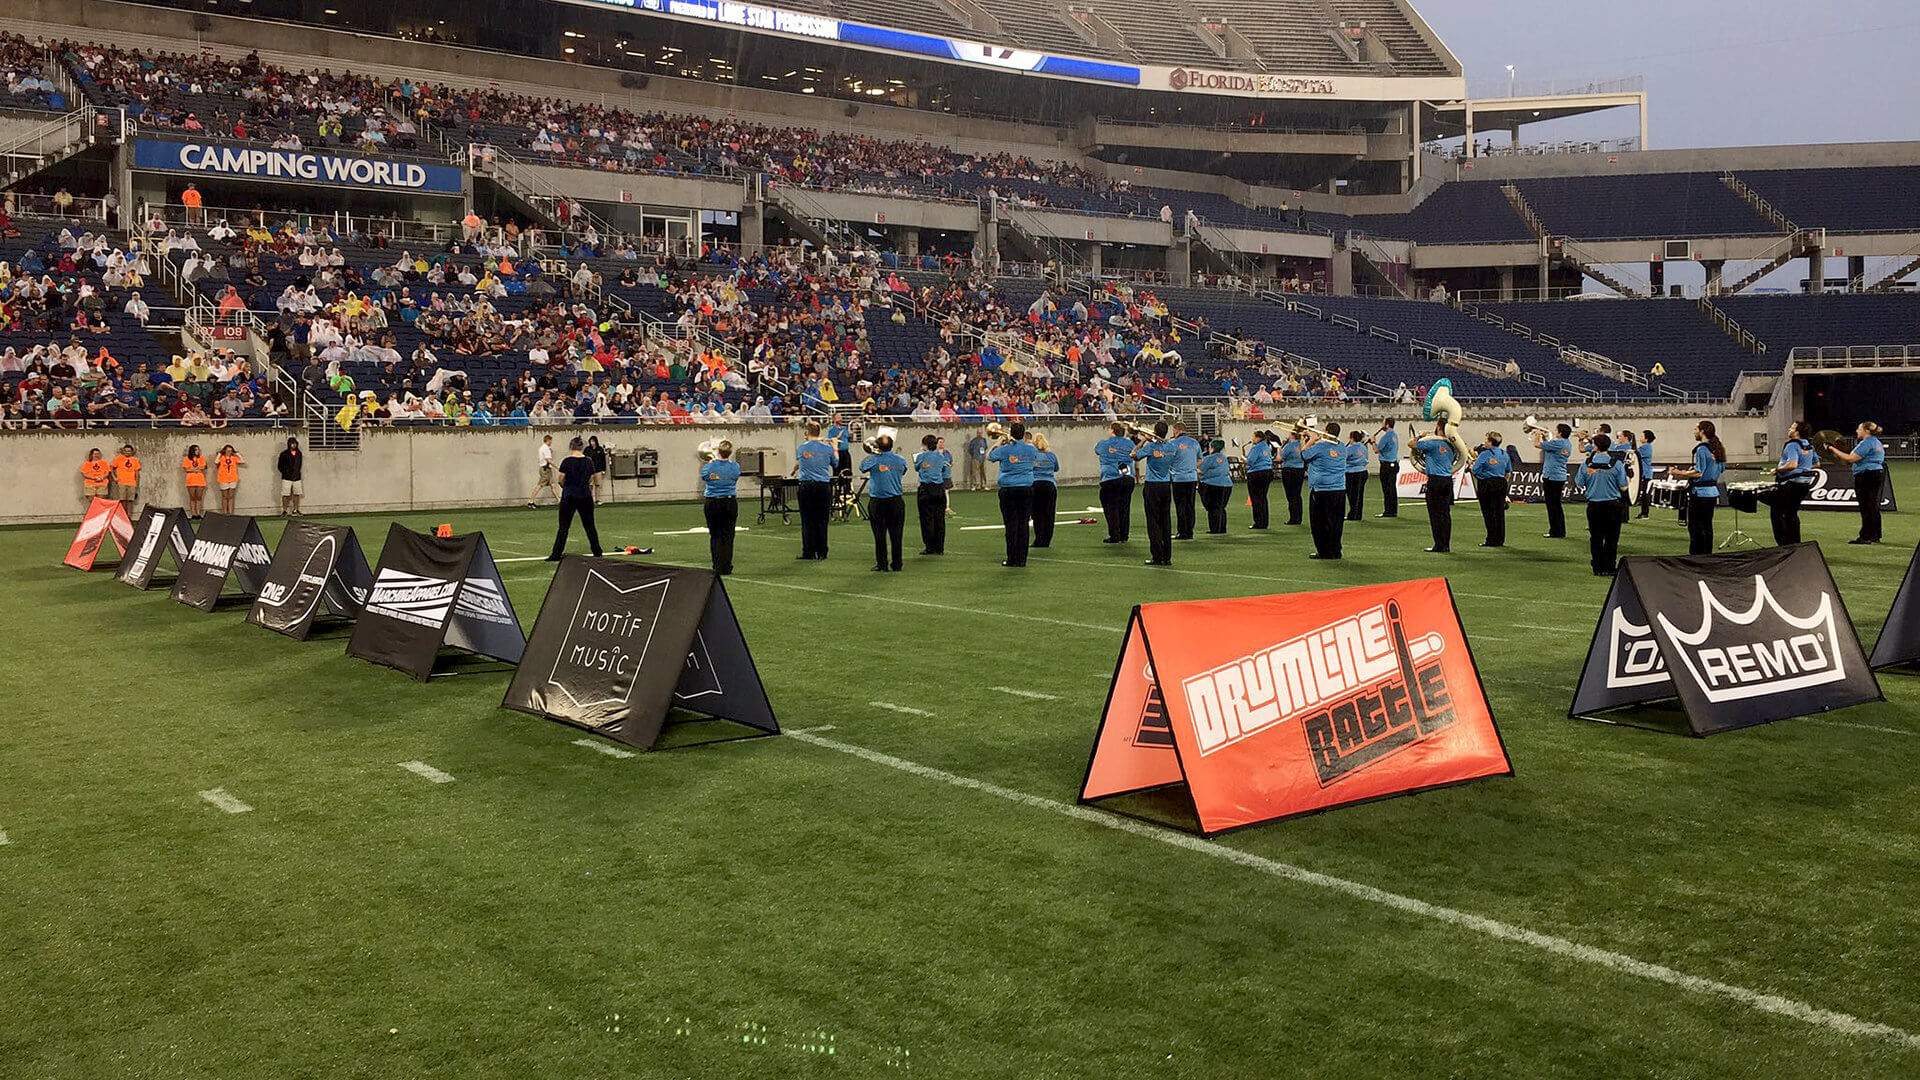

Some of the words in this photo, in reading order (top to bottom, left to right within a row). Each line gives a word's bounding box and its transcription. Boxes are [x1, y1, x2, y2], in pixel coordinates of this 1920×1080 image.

[747, 7, 775, 30] STAR
[1188, 69, 1255, 92] FLORIDA
[179, 144, 318, 179] CAMPING
[321, 155, 427, 188] WORLD
[223, 326, 243, 336] 108
[188, 539, 237, 569] PROMARK
[1697, 633, 1828, 687] REMO
